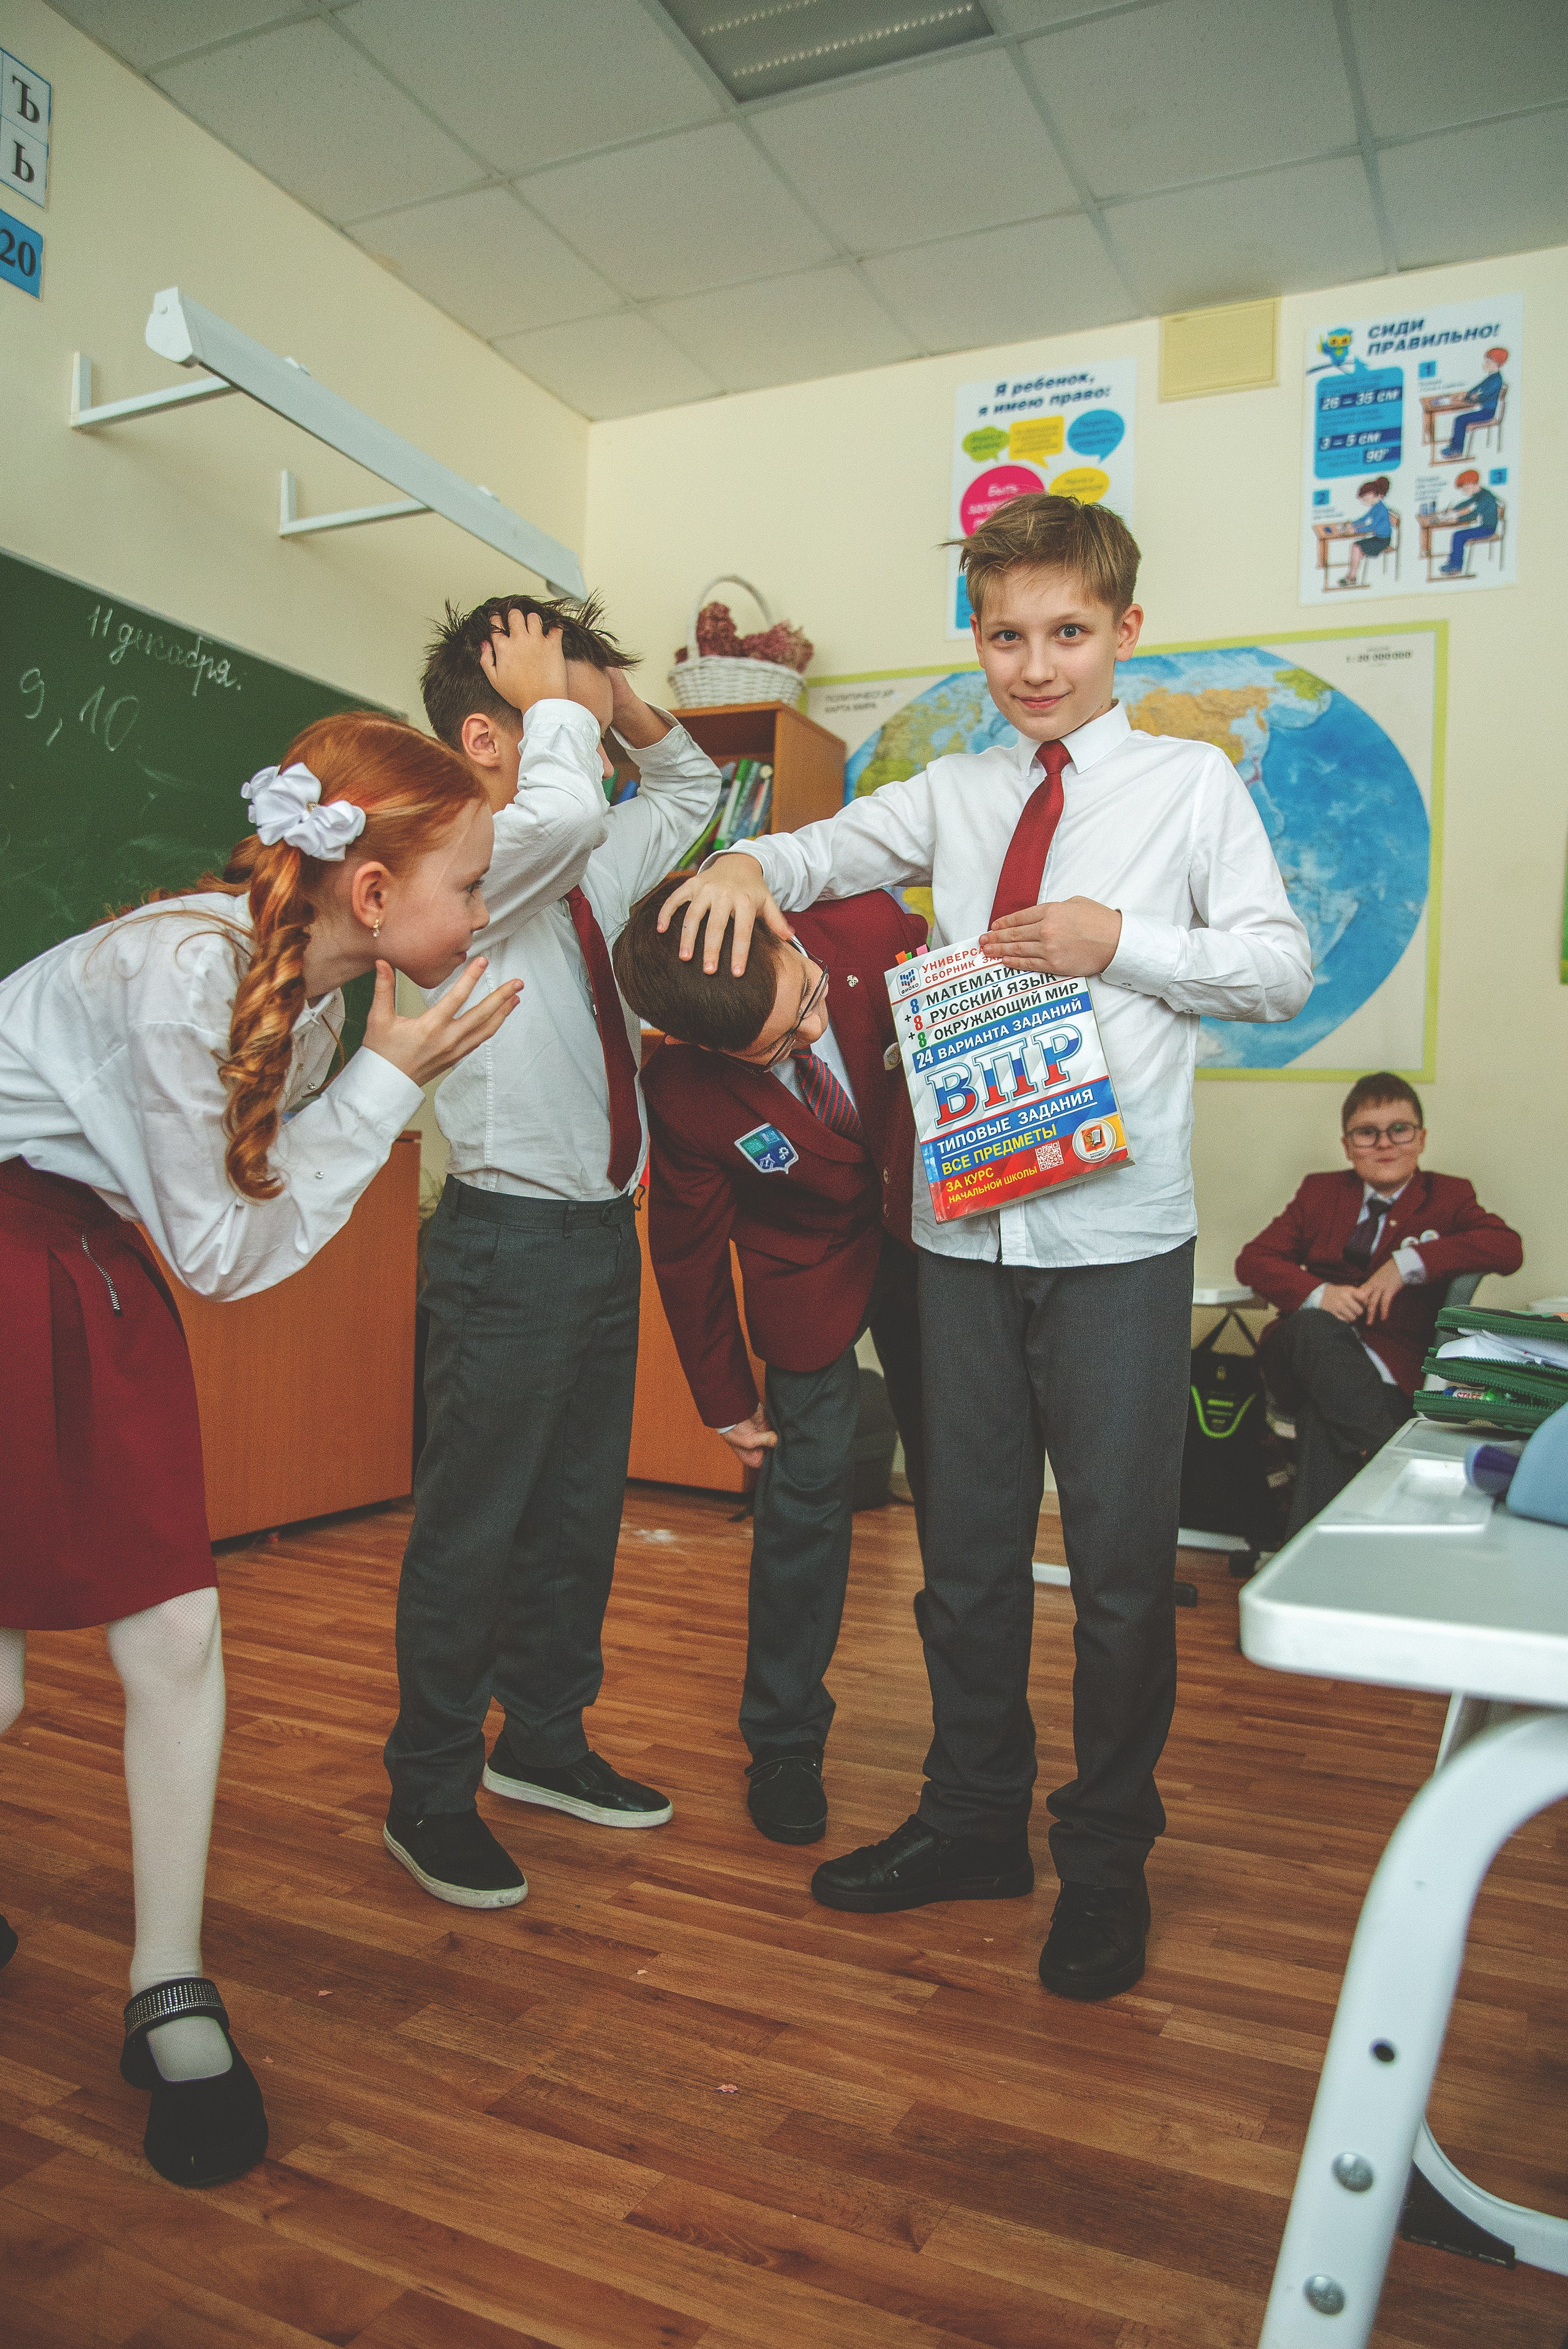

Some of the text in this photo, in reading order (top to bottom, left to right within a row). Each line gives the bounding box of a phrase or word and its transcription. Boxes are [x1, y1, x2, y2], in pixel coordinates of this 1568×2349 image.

[12, 75, 40, 123] Ъ
[12, 140, 35, 183] Ь
[0, 228, 37, 277] 20
[1367, 324, 1501, 356] ПРАВИЛЬНО!
[1368, 318, 1425, 339] СИДИ
[979, 405, 989, 417] я
[993, 398, 1044, 413] имею
[995, 382, 1008, 398] Я
[901, 983, 919, 994] ФИОКО
[910, 967, 1027, 1014] 8 МАТЕМАТИ
[925, 960, 976, 984] СБОРНИК
[913, 1015, 924, 1031] 8
[930, 984, 1003, 1024] РУССКИЙ
[1008, 972, 1057, 994] ЯЗЫК
[917, 1031, 927, 1048] 8
[934, 990, 1042, 1040] ОКРУЖАЮЩИЙ
[1045, 982, 1079, 1001] МИР
[916, 998, 1082, 1069] 24 ВАРИАНТА ЗАДАНИЙ
[924, 1024, 1082, 1128] ВПР
[937, 1088, 1094, 1154] ТИПОВЫЕ ЗАДАНИЯ
[942, 1124, 1057, 1175] ВСЕ ПРЕДМЕТЫ
[946, 1167, 995, 1193] ЗА КУРС
[948, 1166, 1038, 1204] НАЧАЛЬНОЙ ШКОЛЫ
